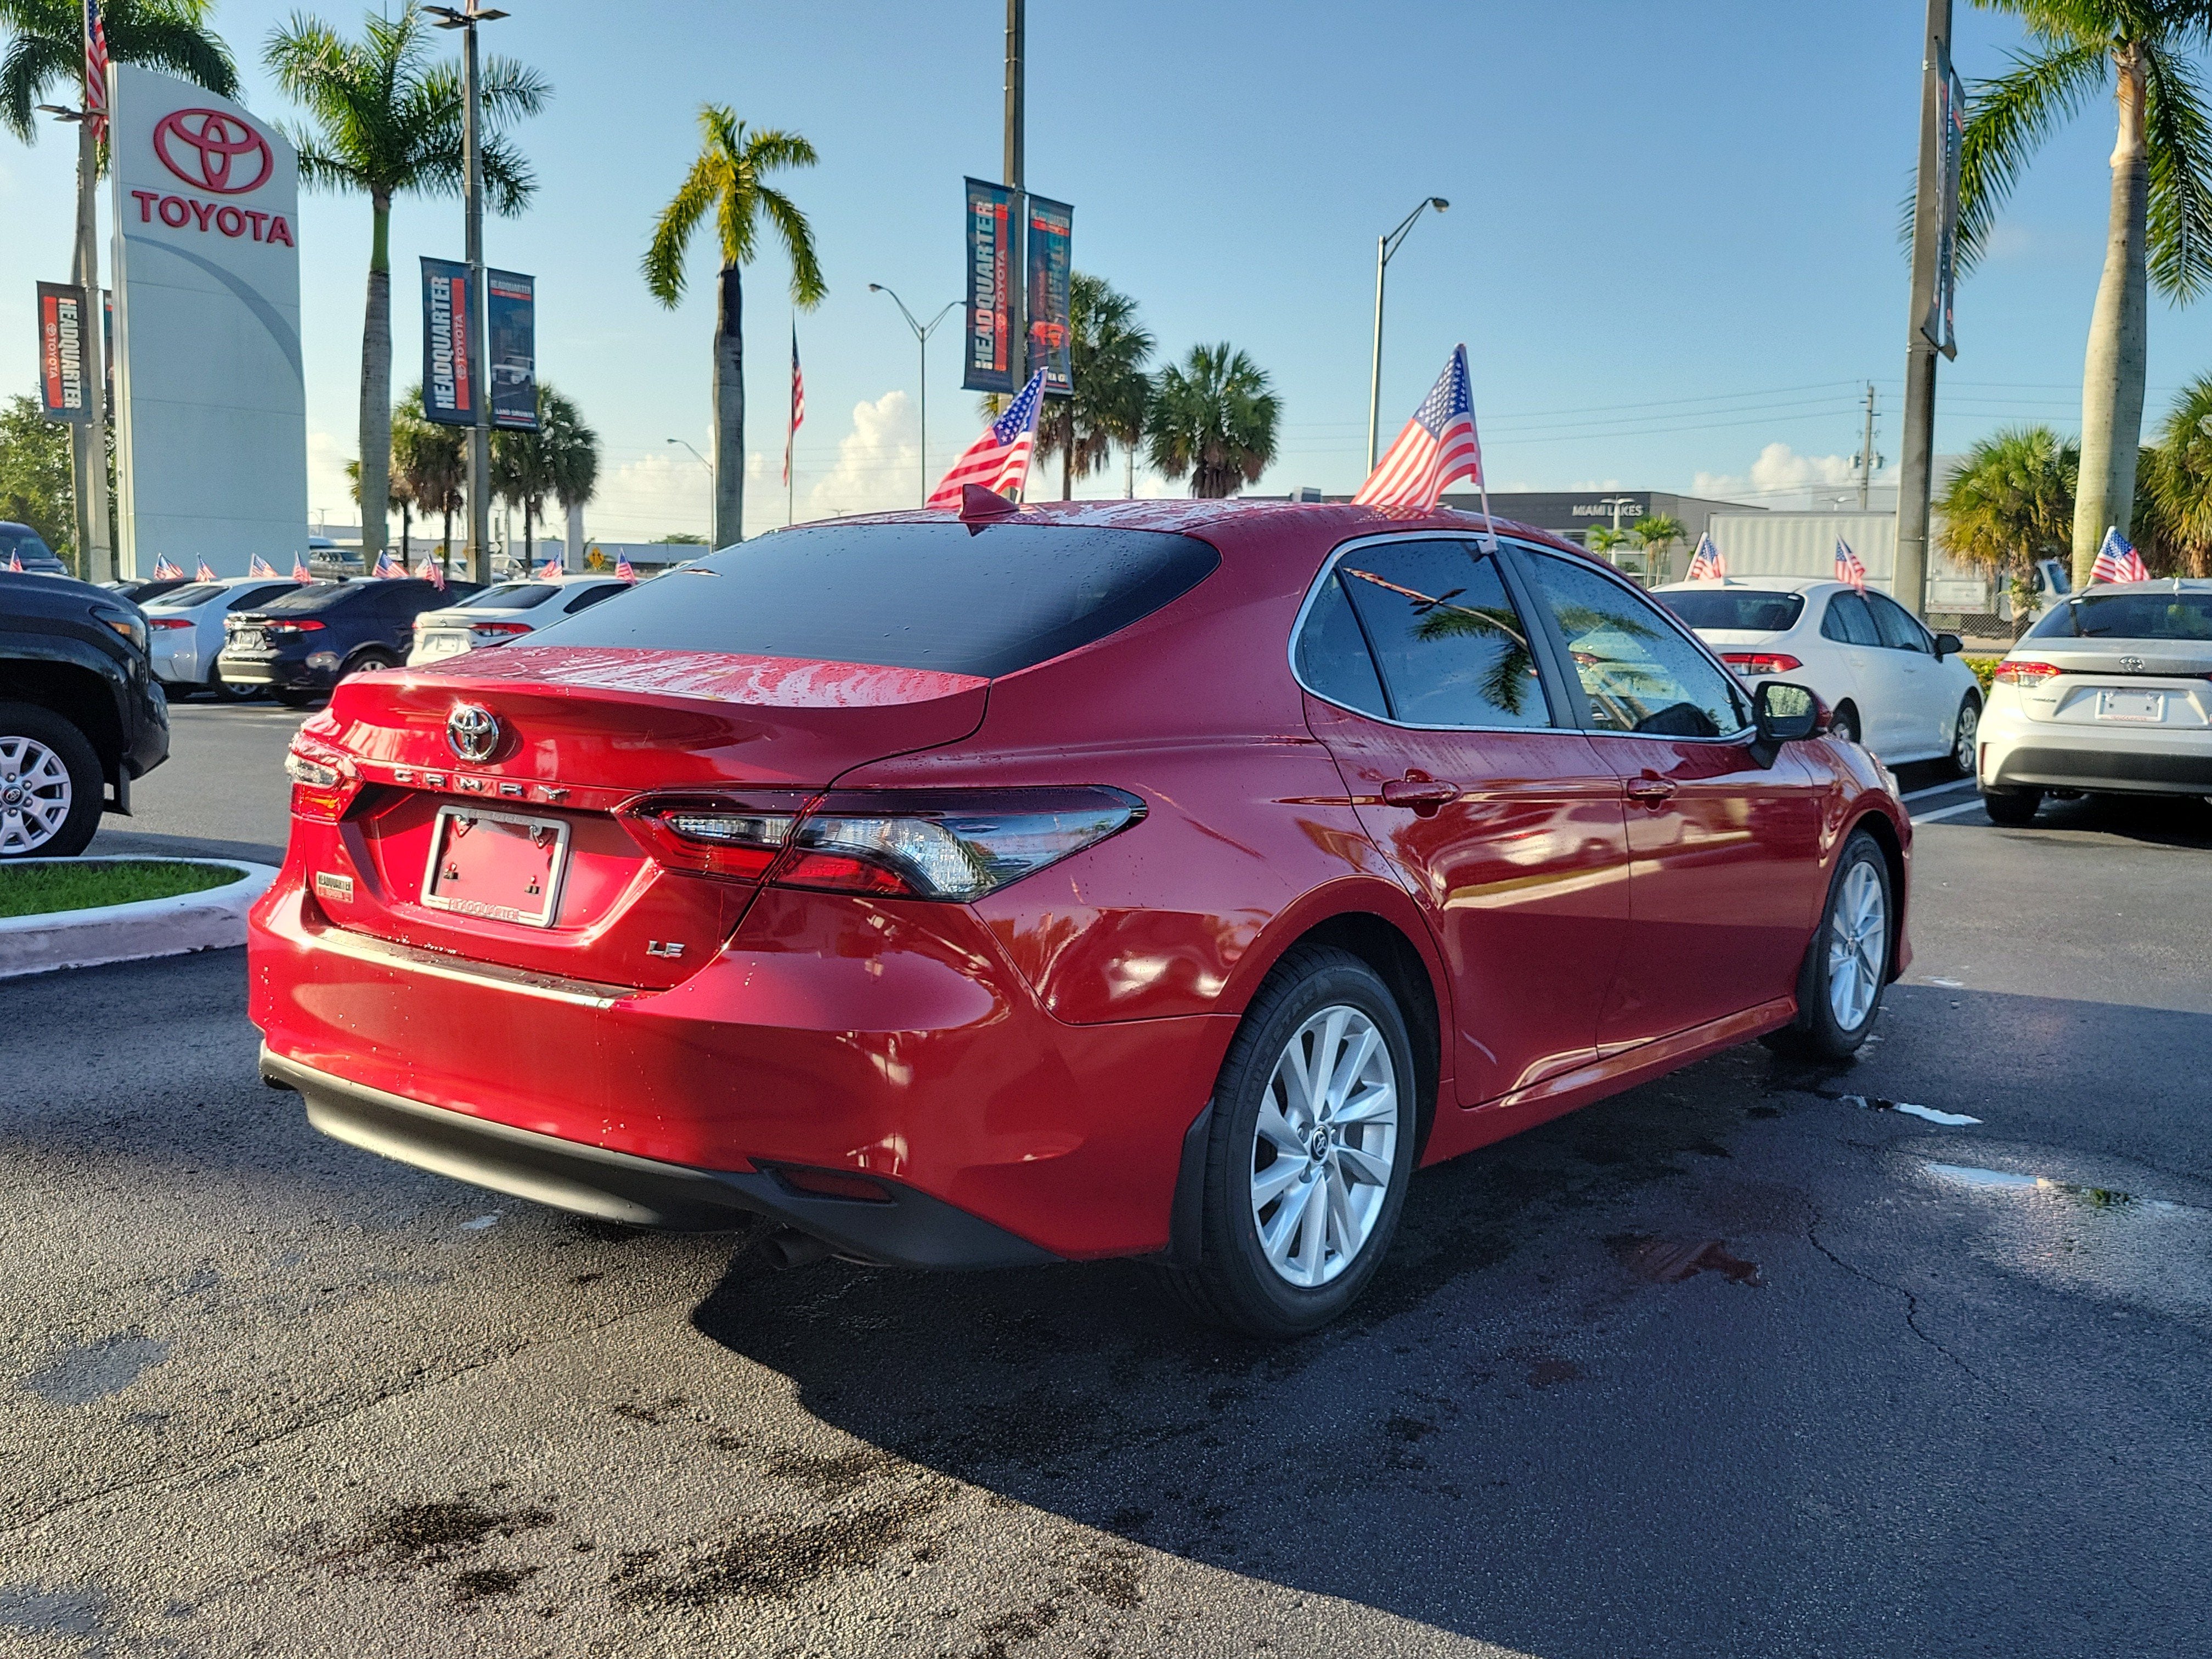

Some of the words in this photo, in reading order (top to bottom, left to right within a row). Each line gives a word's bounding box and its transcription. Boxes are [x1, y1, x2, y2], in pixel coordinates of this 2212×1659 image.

[132, 190, 295, 247] TOYOTA
[974, 201, 995, 370] HEADQUARTER
[996, 250, 1006, 311] TOYOTA
[48, 338, 59, 379] TOYOTA
[58, 297, 82, 409] HEADQUARTER
[431, 275, 455, 409] HEADQUARTER
[453, 314, 464, 363] TOYOTA
[1572, 504, 1606, 516] MIAMI
[1607, 504, 1644, 516] LKES
[394, 768, 570, 799] CAMRY
[449, 897, 520, 922] HEADQUARTER
[646, 940, 685, 958] LE
